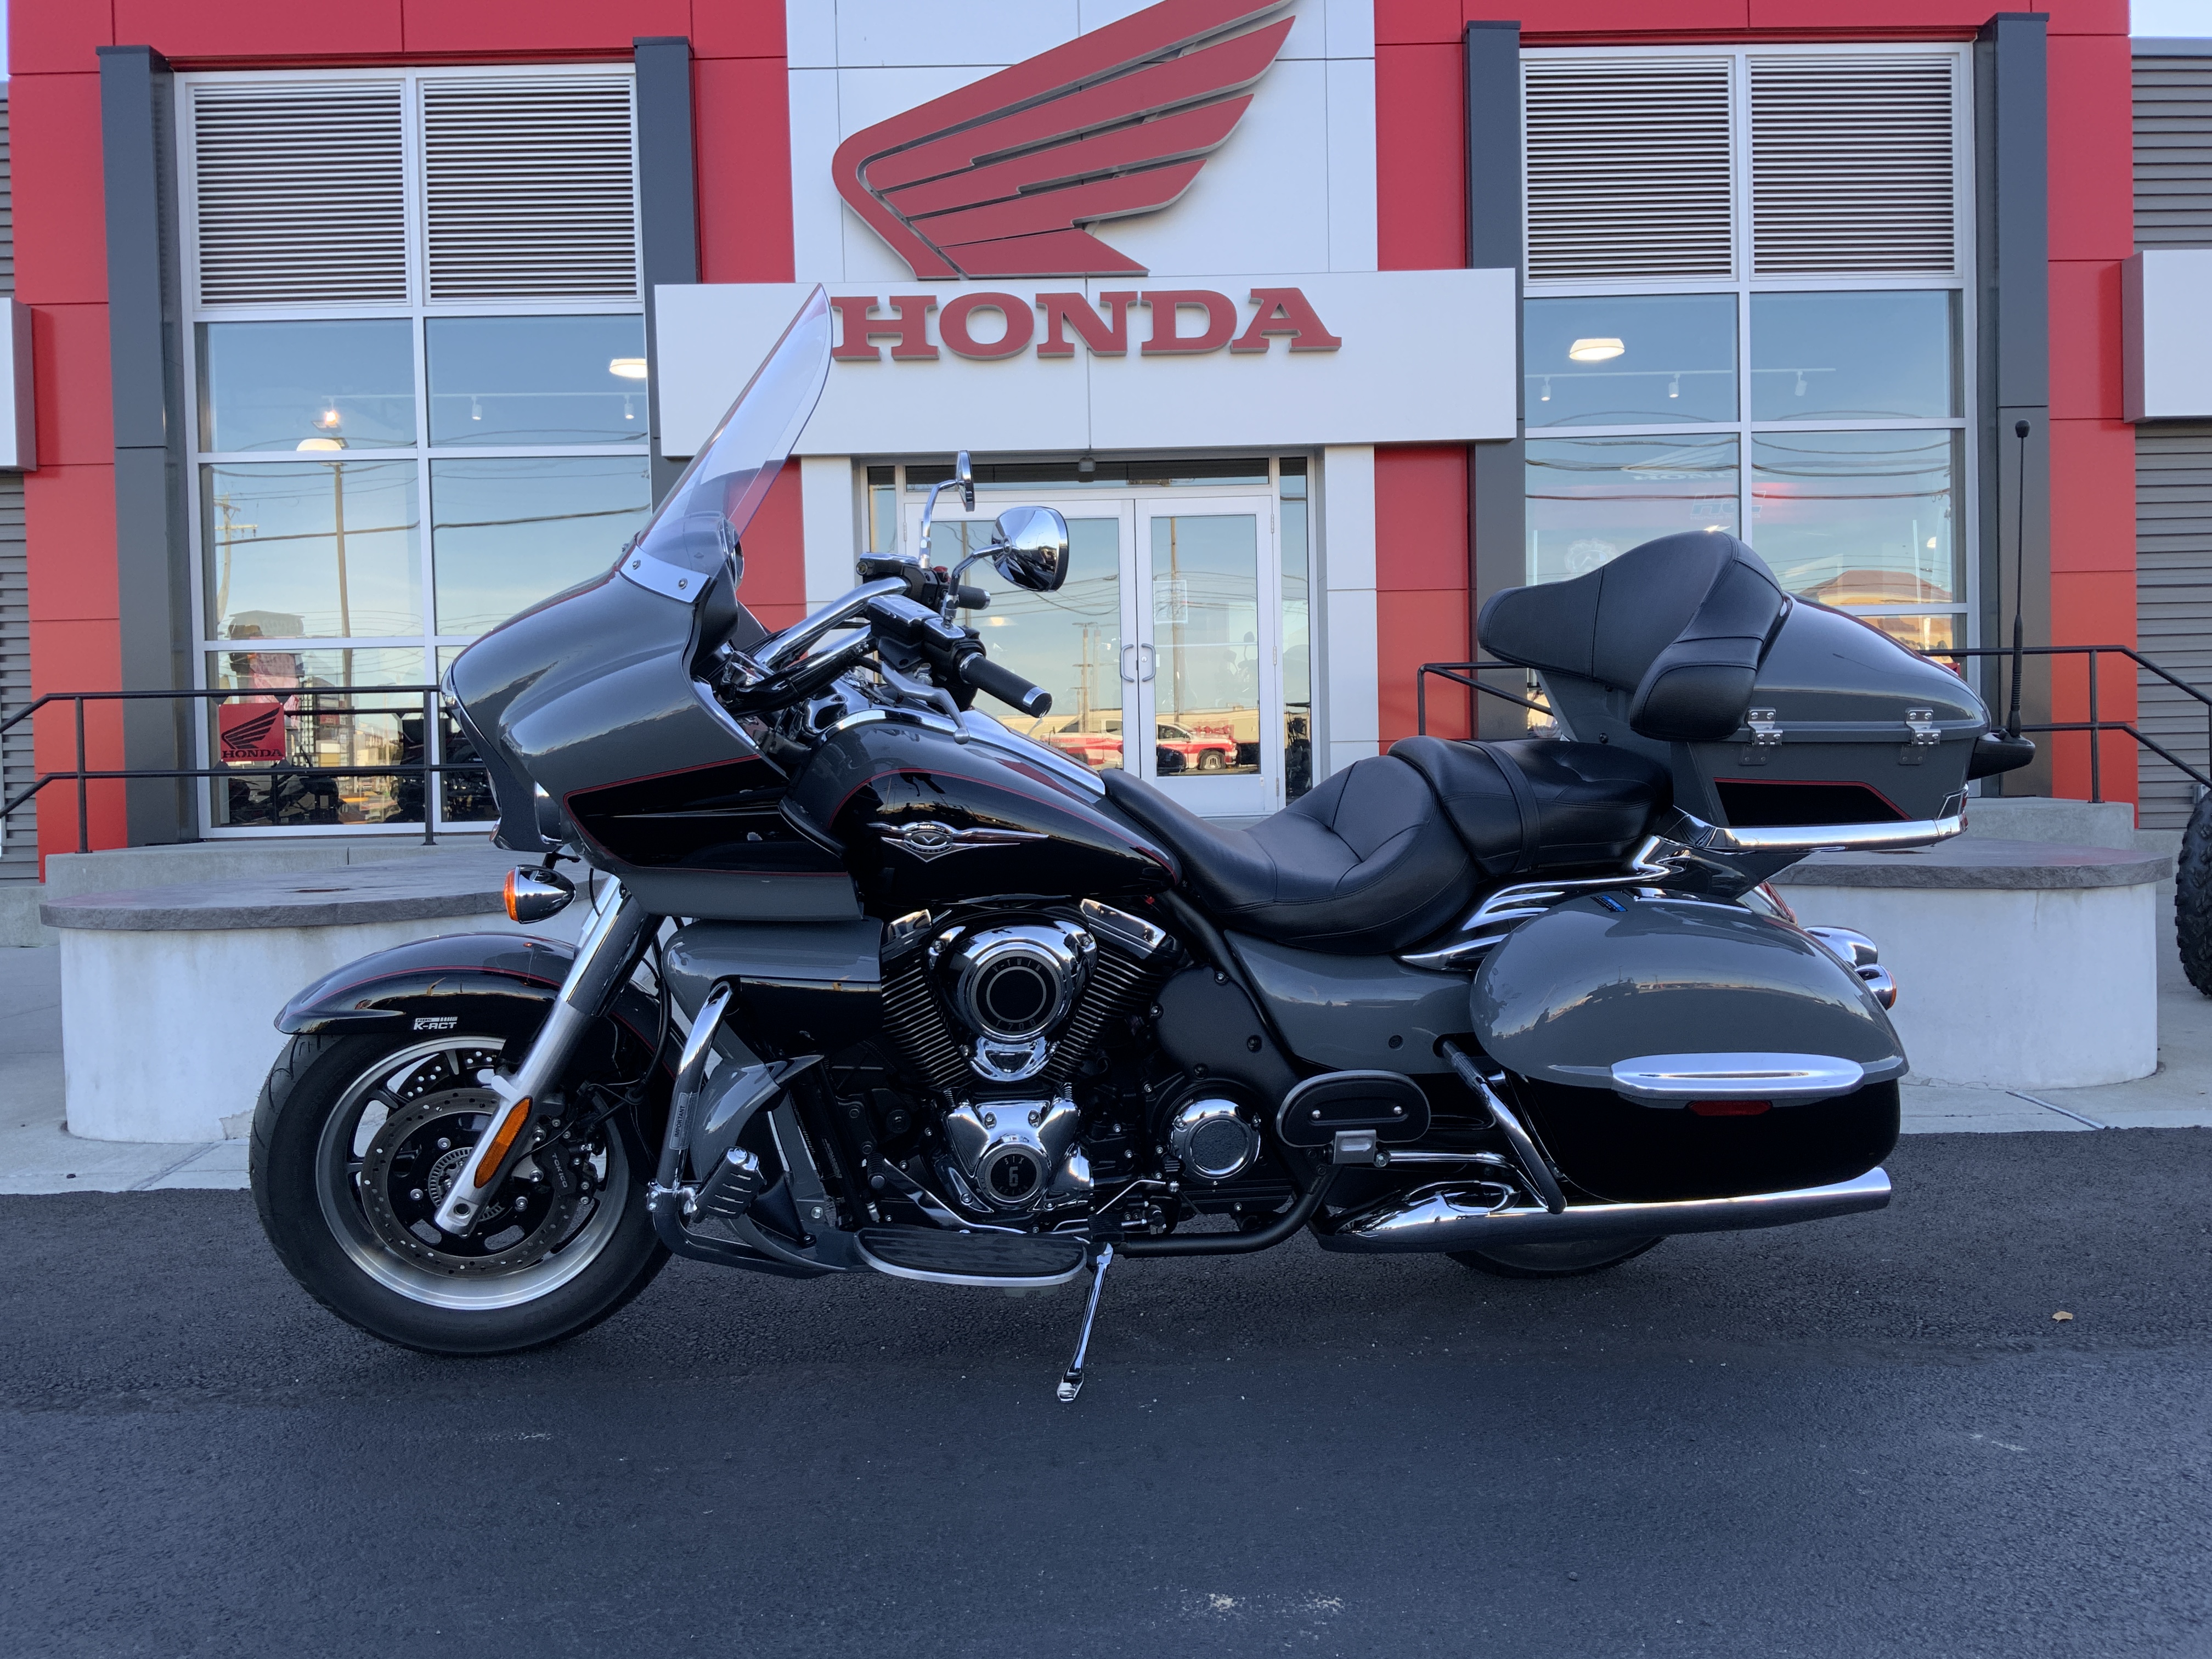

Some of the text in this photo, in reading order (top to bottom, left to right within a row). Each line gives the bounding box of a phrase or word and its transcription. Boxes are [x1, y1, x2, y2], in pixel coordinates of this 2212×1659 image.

[830, 286, 1342, 361] HONDA
[222, 748, 284, 758] HONDA
[992, 958, 1042, 972] V-TWIN
[413, 1022, 457, 1030] K-ACT
[995, 1018, 1036, 1030] 1700
[674, 1105, 685, 1138] IMPORTANT
[1004, 1155, 1025, 1165] SIX
[552, 1152, 568, 1188] TOKICO
[1009, 1166, 1019, 1187] 6
